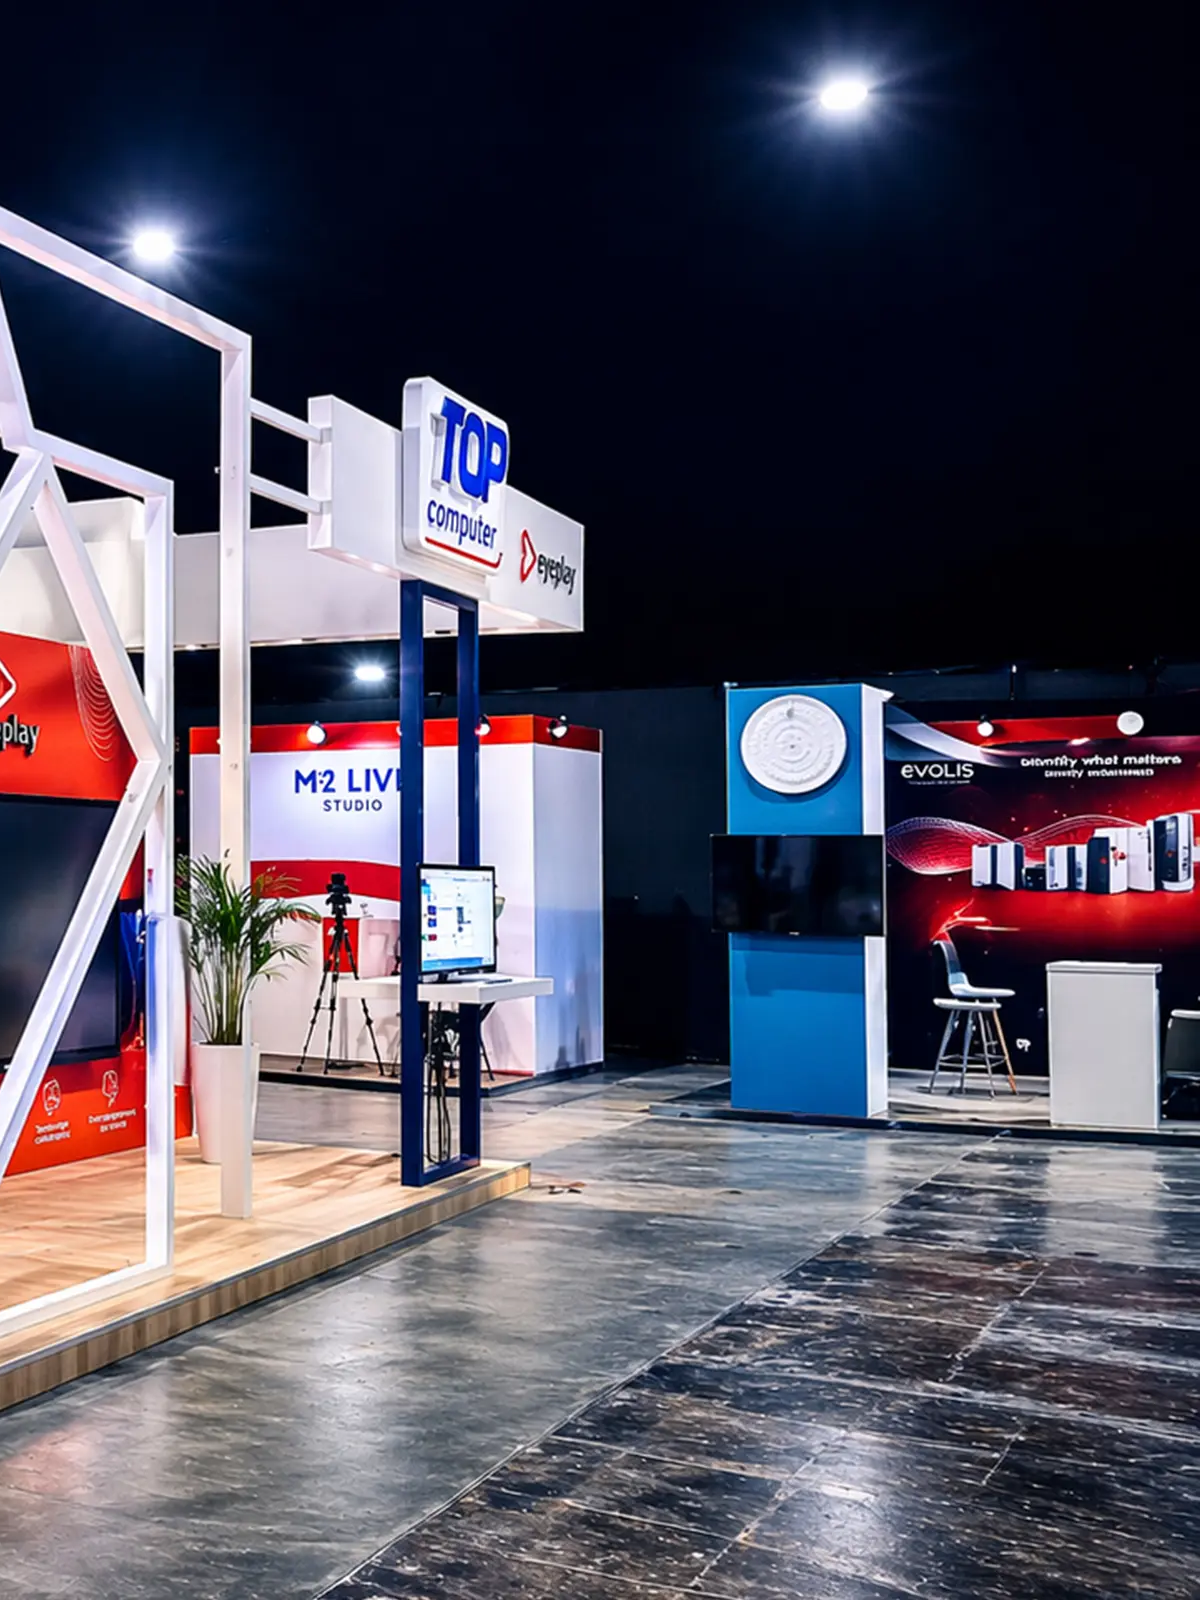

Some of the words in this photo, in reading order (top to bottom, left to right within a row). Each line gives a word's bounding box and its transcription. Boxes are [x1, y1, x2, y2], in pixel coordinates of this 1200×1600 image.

[441, 396, 508, 503] TOP
[427, 500, 498, 549] computer
[537, 555, 577, 595] eyeplay
[323, 798, 383, 812] STUDIO
